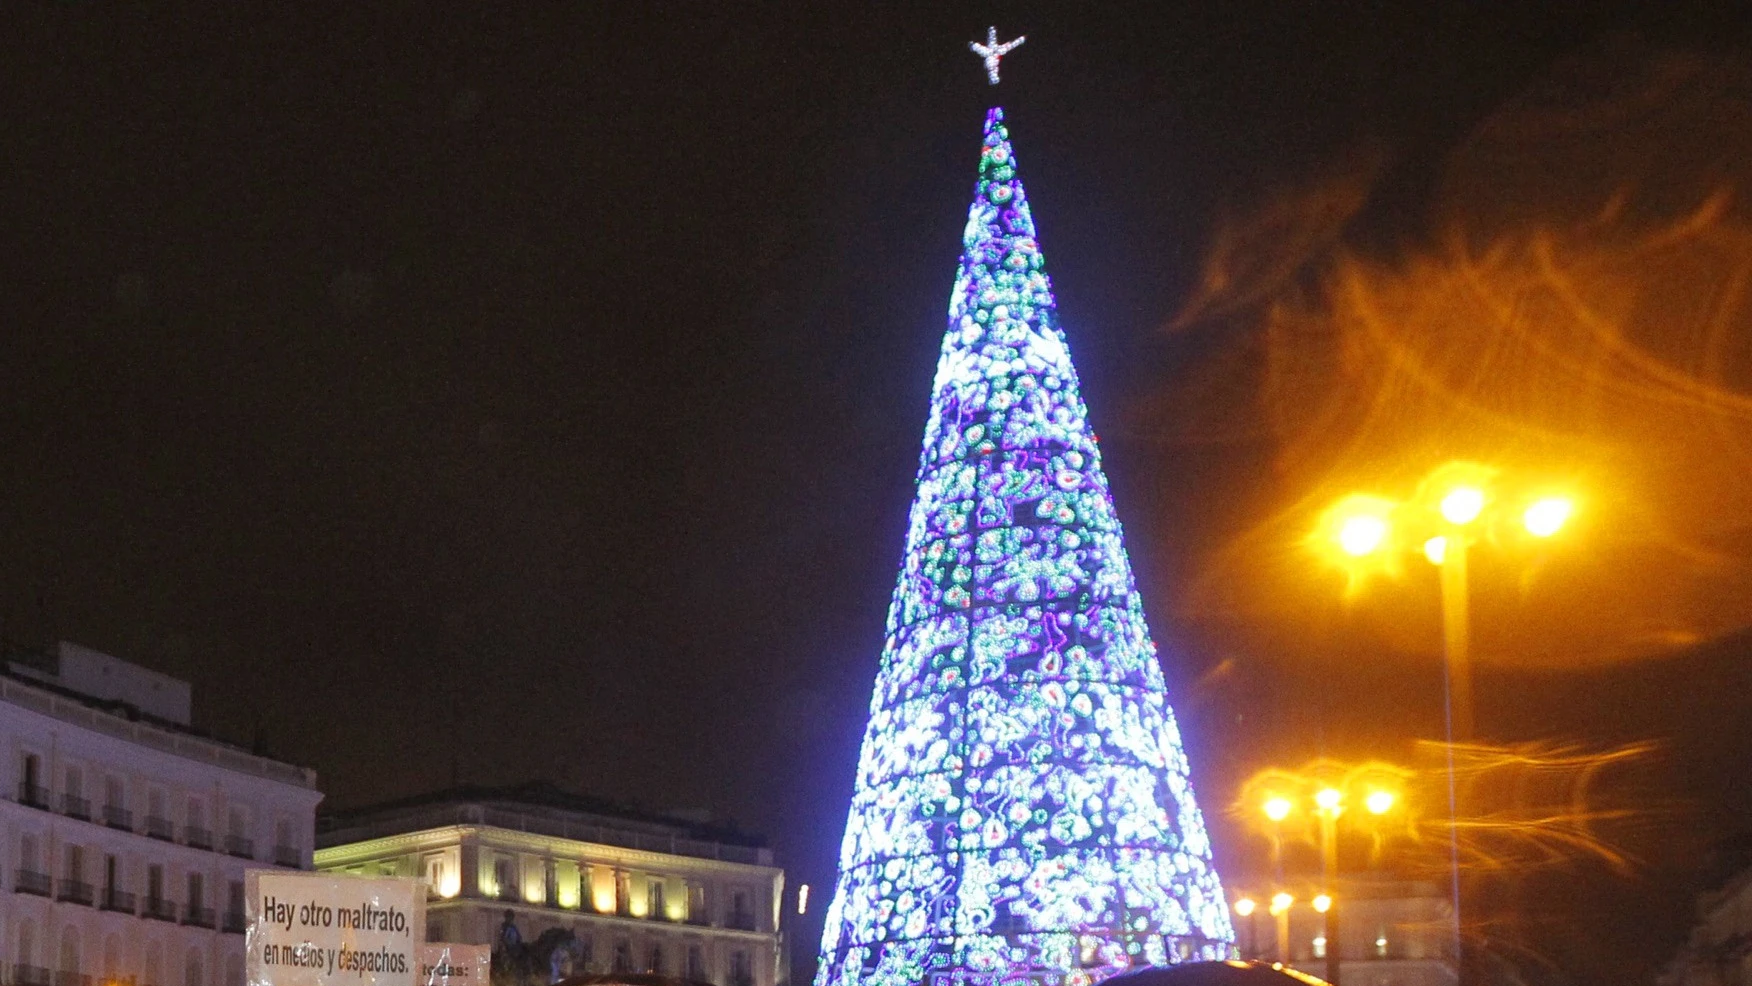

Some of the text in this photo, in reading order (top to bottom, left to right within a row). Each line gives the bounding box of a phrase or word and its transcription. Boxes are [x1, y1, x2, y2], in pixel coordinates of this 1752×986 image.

[264, 896, 410, 937] Hay otro maltrato,
[264, 941, 409, 978] en medios y despachos.
